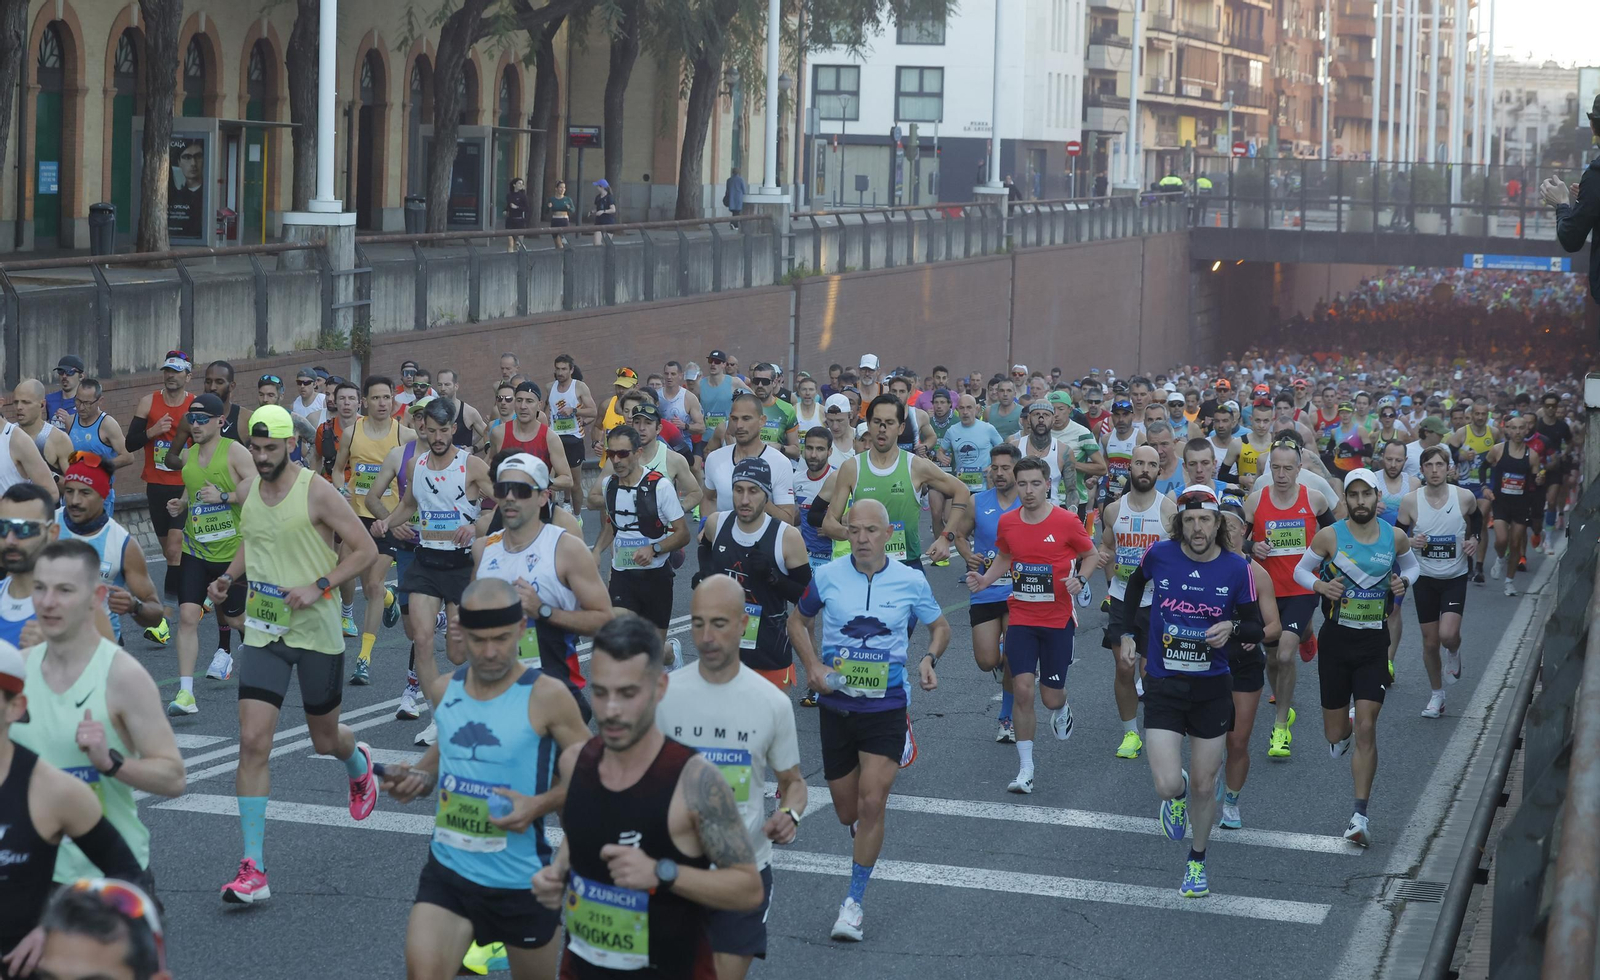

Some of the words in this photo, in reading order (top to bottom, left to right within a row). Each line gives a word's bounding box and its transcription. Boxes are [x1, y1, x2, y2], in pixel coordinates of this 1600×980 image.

[194, 526, 205, 534] LA
[886, 542, 905, 551] OITIA
[1271, 538, 1301, 548] SEAMUS
[623, 558, 636, 566] DAV
[262, 584, 284, 596] ZURIC
[1021, 583, 1044, 592] HENRI
[1160, 598, 1223, 617] MADRID
[257, 606, 277, 622] LEÓN
[1180, 641, 1196, 650] 3810
[853, 651, 883, 660] ZURICH
[1166, 649, 1206, 661] DANIELA
[852, 666, 869, 674] 2474
[846, 675, 879, 687] OZANO
[702, 752, 743, 763] ZURICH
[459, 782, 496, 798] ZURIC
[446, 813, 494, 835] MIKELE
[588, 885, 636, 907] ZURICH
